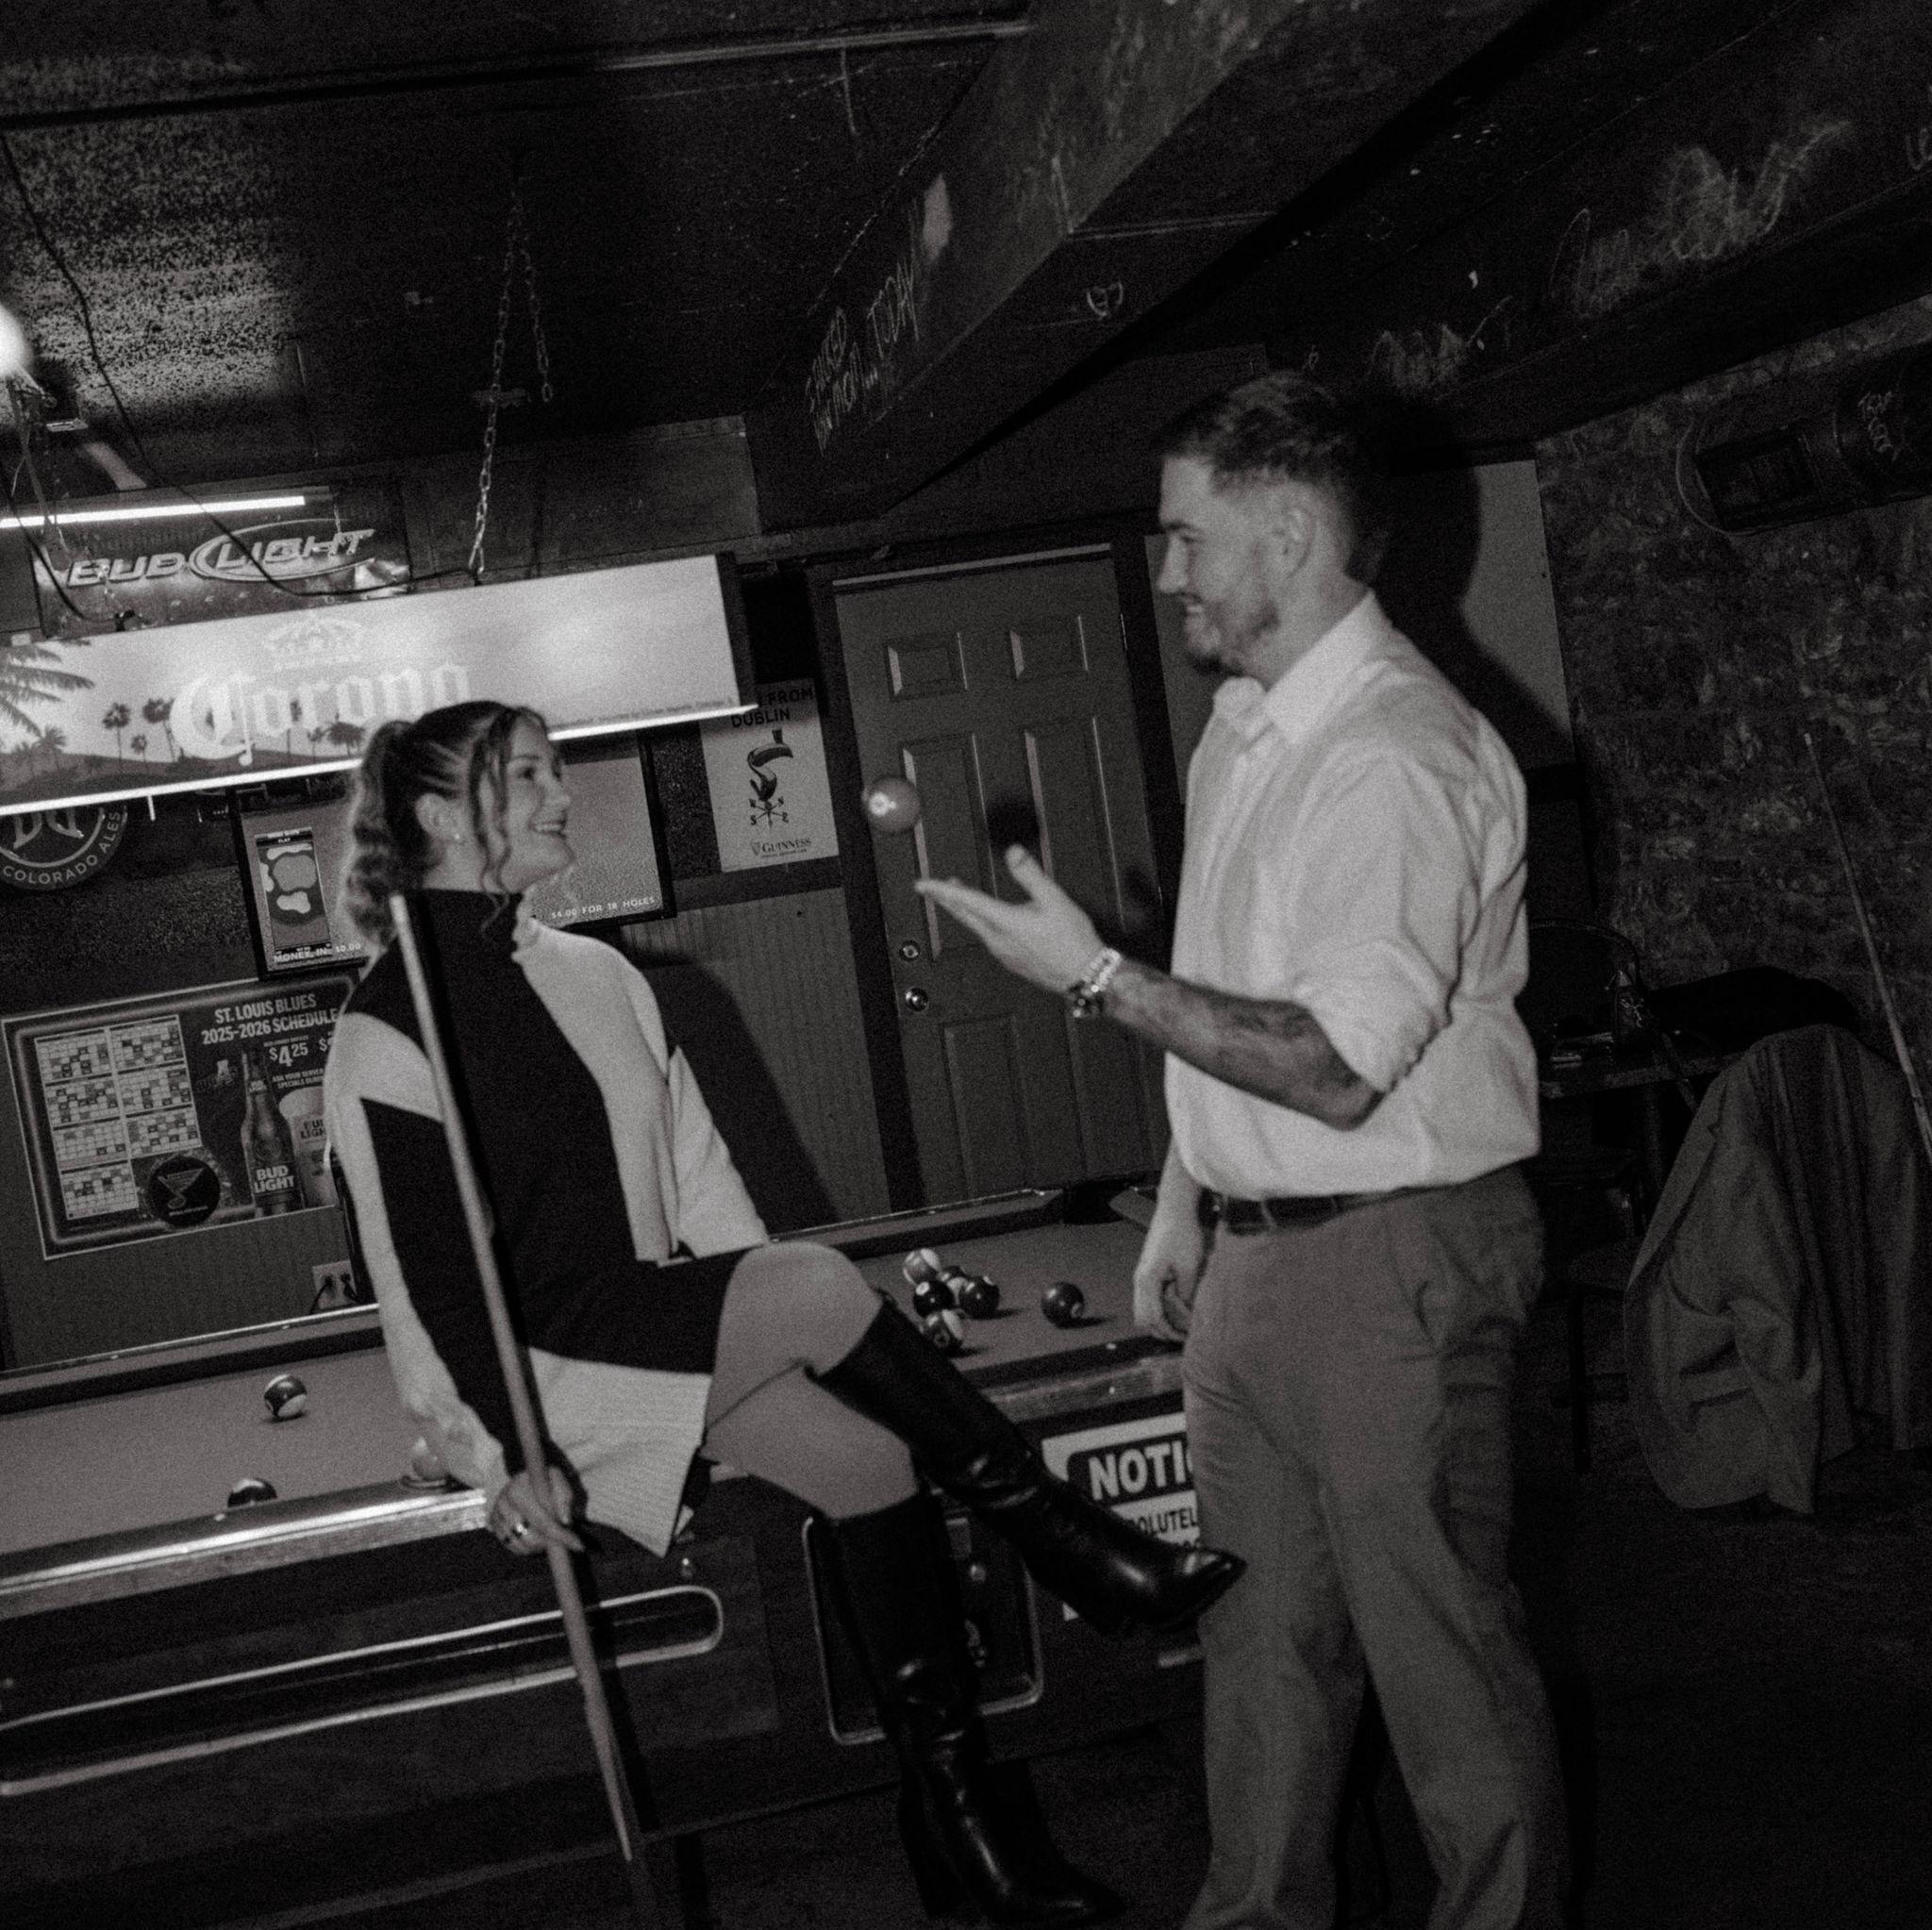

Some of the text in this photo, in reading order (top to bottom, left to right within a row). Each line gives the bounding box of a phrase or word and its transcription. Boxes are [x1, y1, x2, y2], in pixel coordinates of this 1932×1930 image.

[68, 528, 375, 587] BUD LIGHT
[767, 688, 814, 706] FROM
[171, 660, 471, 765] Corona
[731, 708, 791, 728] DUBLIN
[2, 854, 98, 885] COLORADO
[98, 811, 121, 854] ALES
[762, 838, 811, 854] GUINNESS
[582, 904, 603, 914] FOR
[623, 895, 656, 908] HOLES
[274, 950, 312, 963] MONEY
[214, 993, 317, 1024] ST. LOUIS BLUES
[201, 1019, 272, 1045] 2025-2026
[273, 1008, 339, 1033] SCHEDULE
[257, 1165, 290, 1181] BUD
[253, 1174, 294, 1193] LIGHT
[1137, 1506, 1198, 1535] OLUTEL
